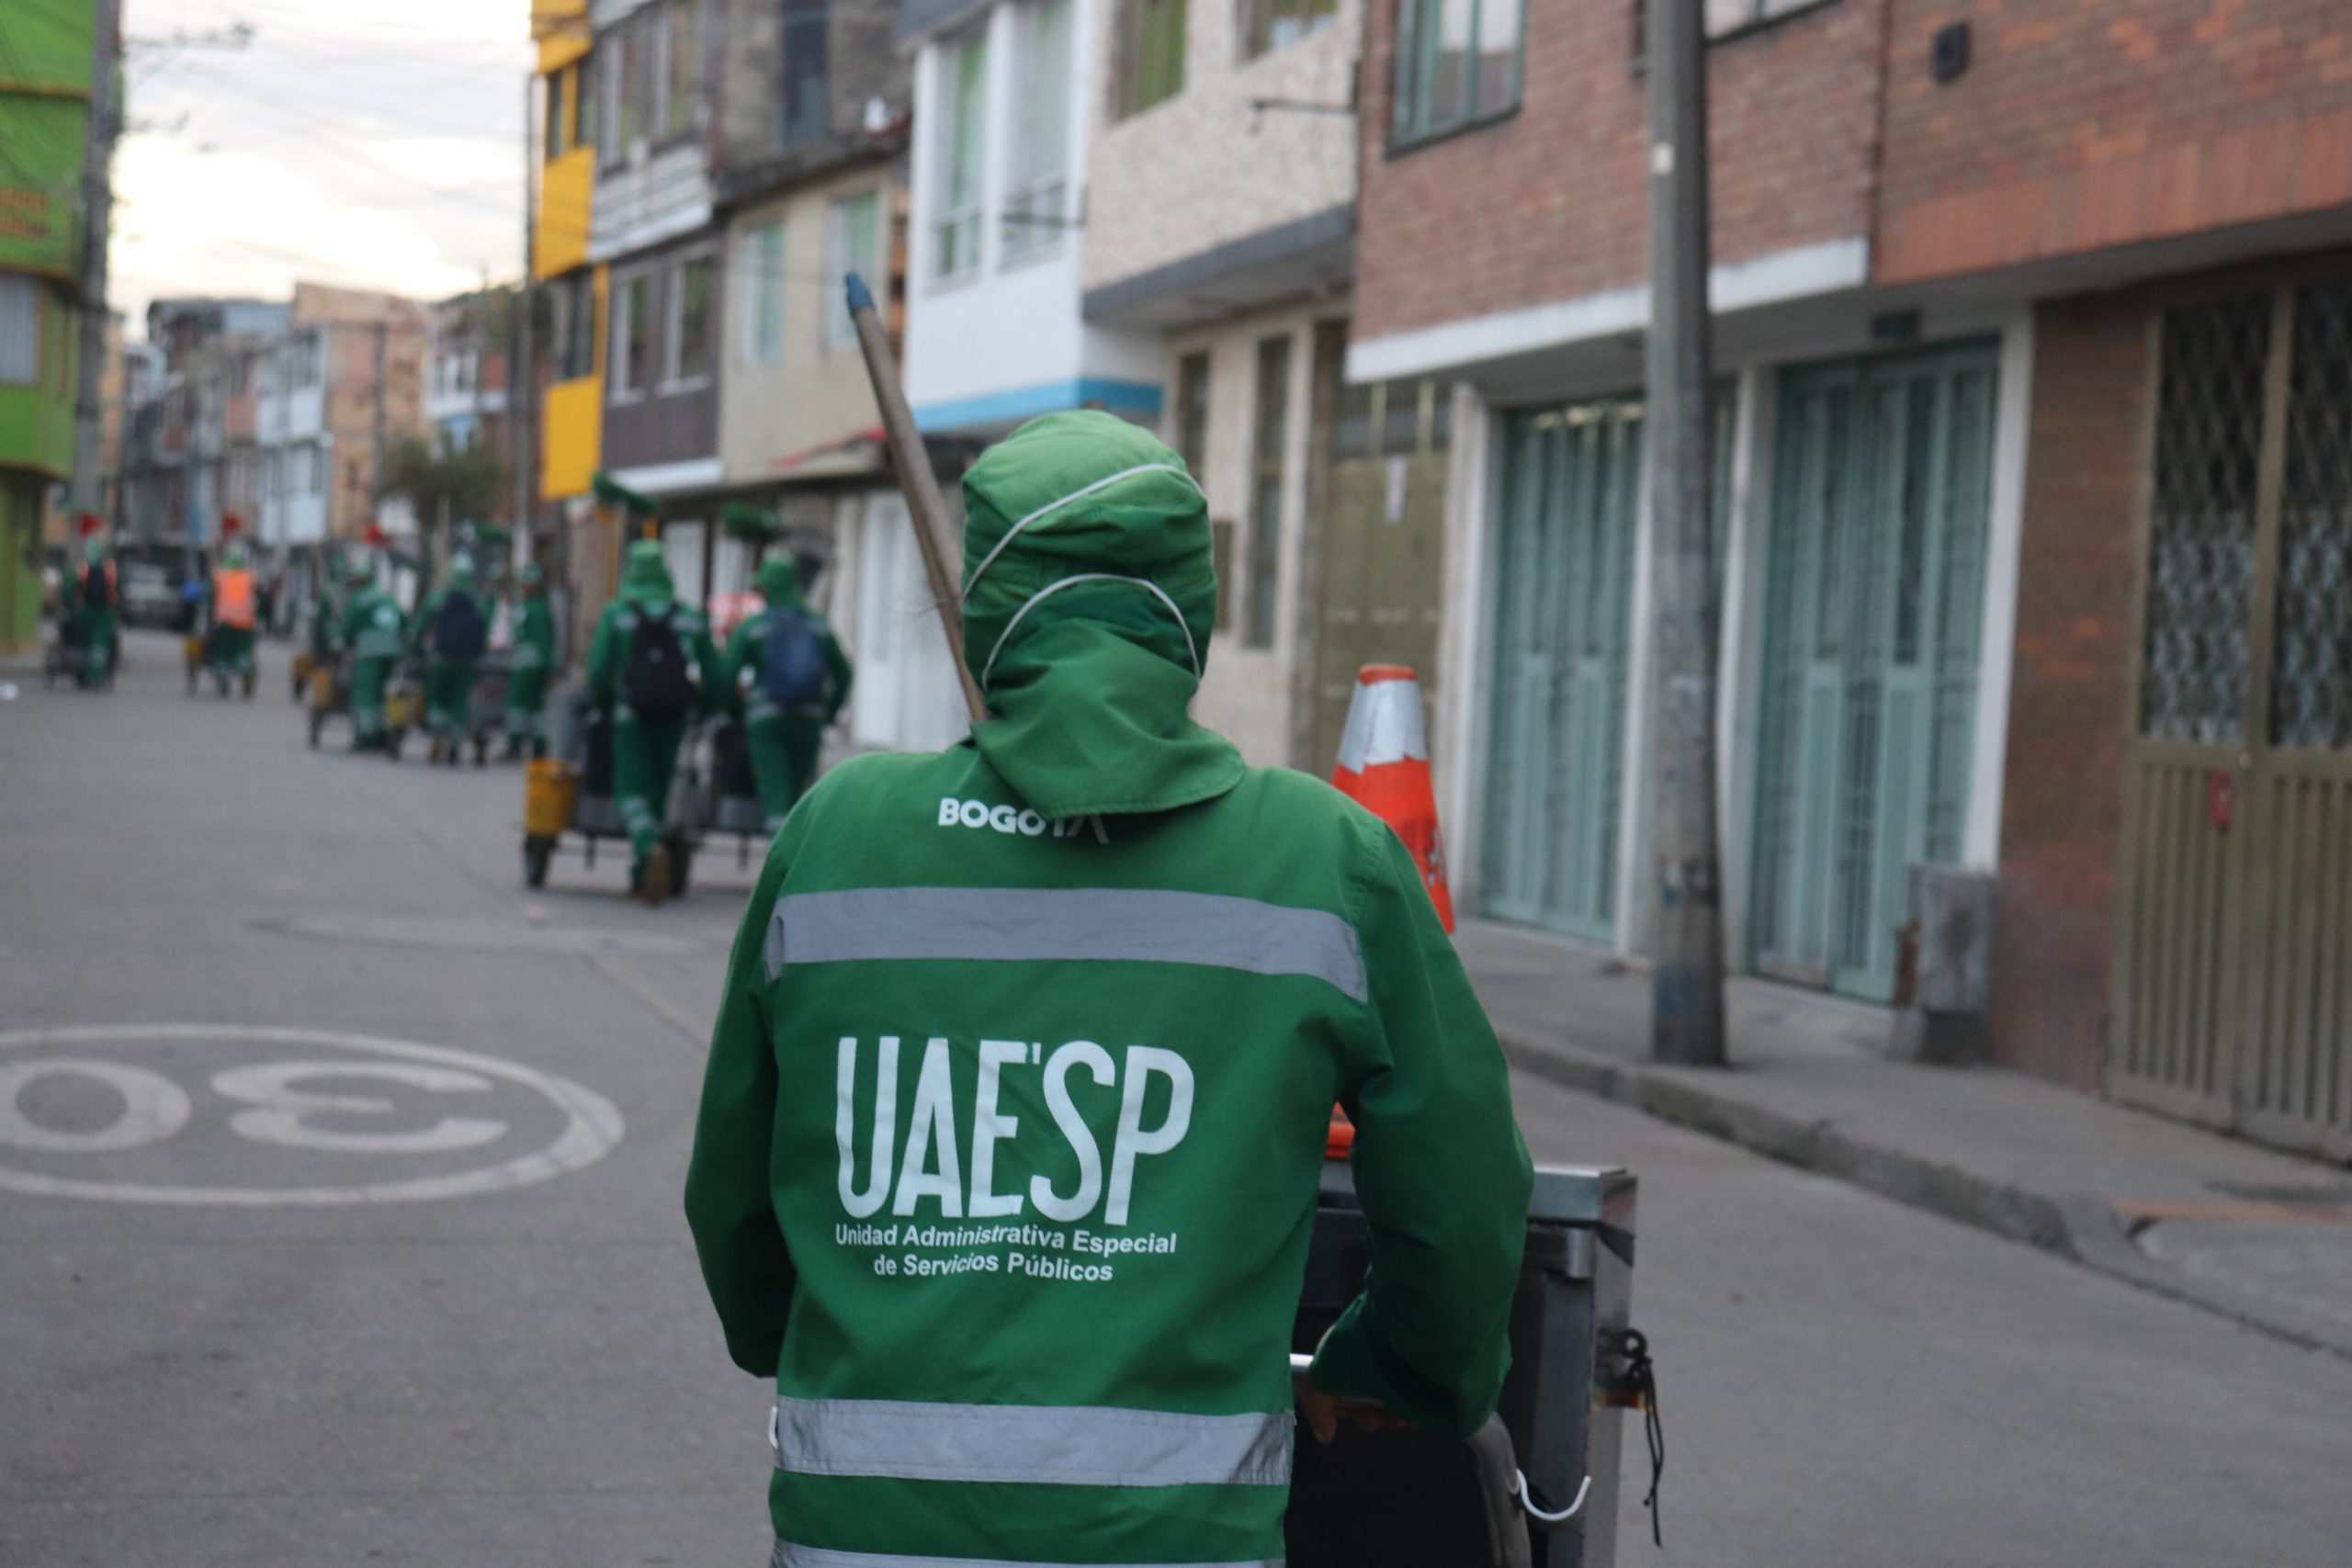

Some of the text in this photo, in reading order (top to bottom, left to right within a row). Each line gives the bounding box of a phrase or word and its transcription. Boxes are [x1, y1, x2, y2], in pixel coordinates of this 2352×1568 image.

[835, 1035, 1195, 1226] UAESP
[835, 1223, 1178, 1258] Unidad Administrativa Especial
[873, 1252, 1114, 1282] de Servicios Públicos
